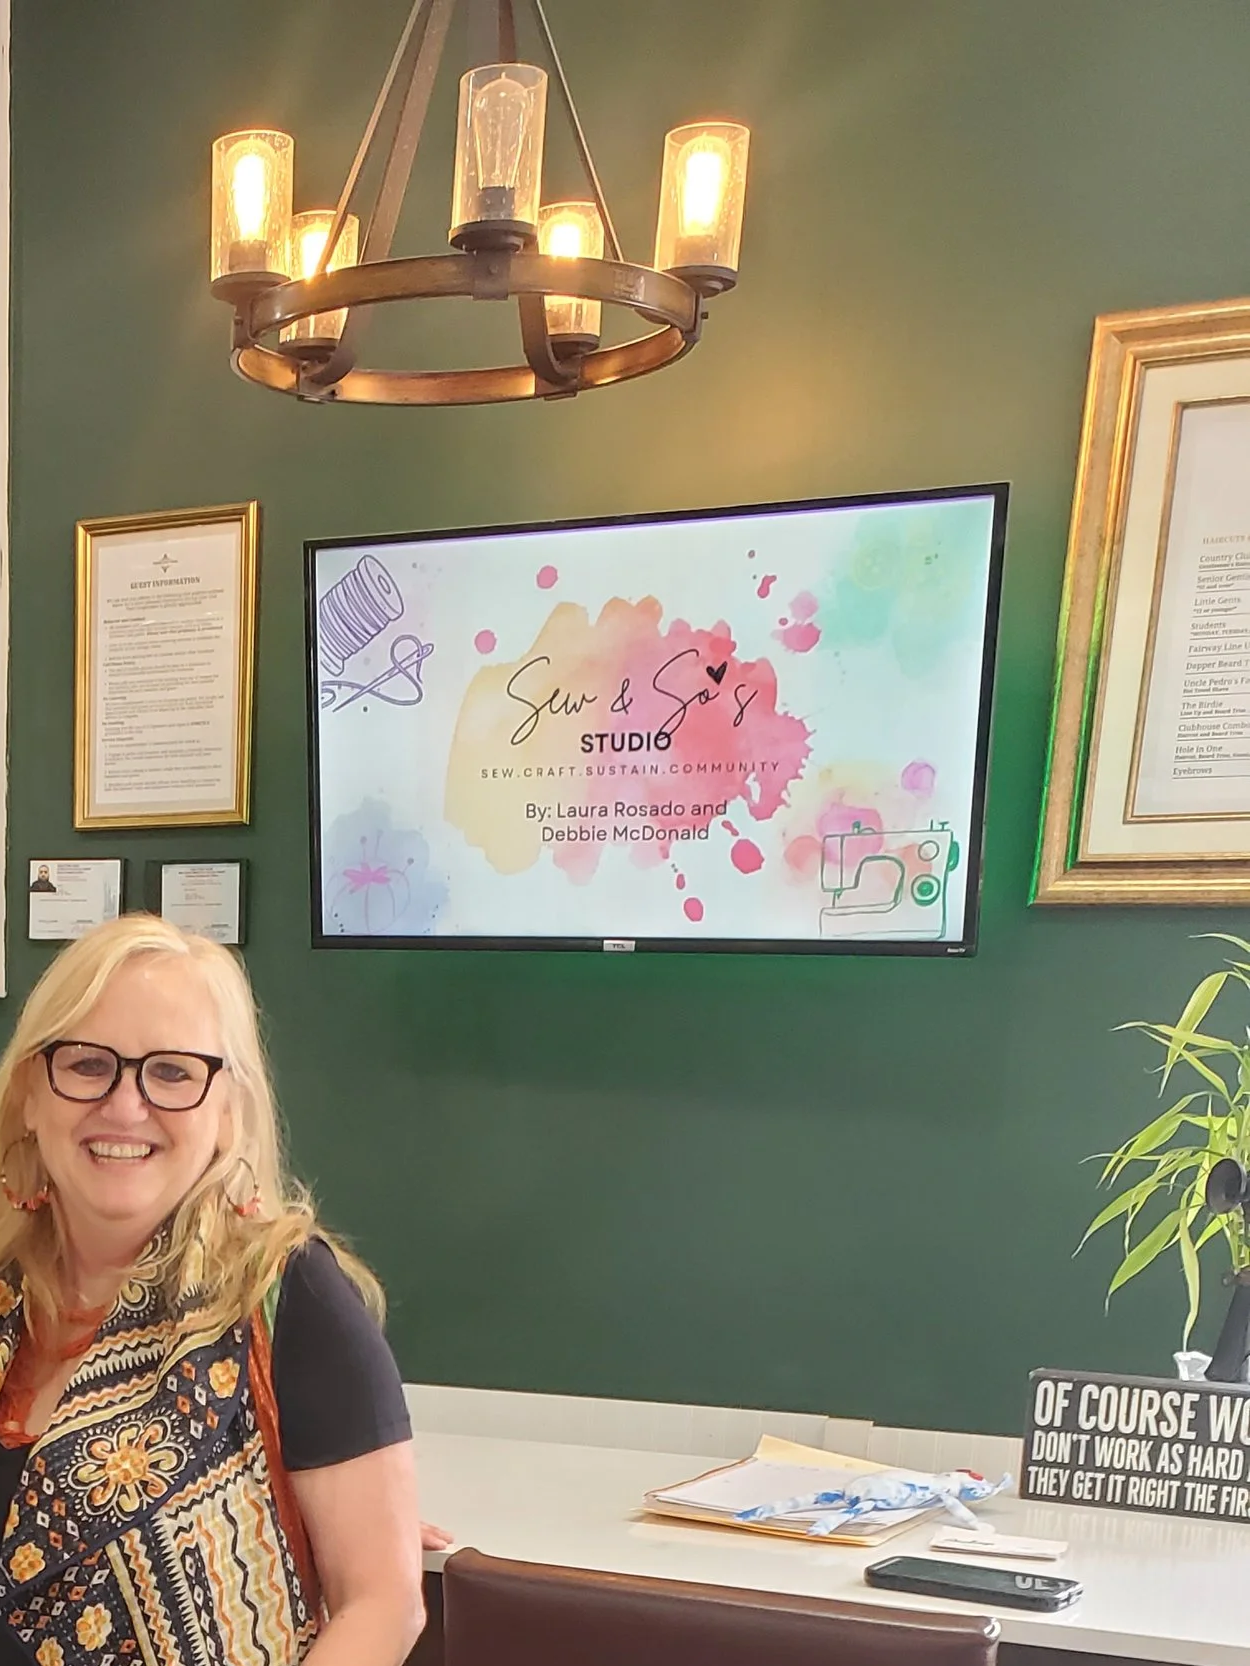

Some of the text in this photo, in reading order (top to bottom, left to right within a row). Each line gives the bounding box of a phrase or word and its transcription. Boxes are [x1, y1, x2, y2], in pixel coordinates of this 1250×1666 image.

[1199, 554, 1234, 563] Country
[130, 576, 200, 589] GUEST INFORMATION
[1197, 575, 1224, 583] Senior
[1194, 598, 1216, 606] Little
[1188, 644, 1223, 653] Fairway
[1224, 643, 1243, 651] Line
[1186, 662, 1217, 671] Dapper
[1217, 659, 1243, 668] Beard
[1183, 679, 1207, 687] Uncle
[506, 656, 598, 746] Sew
[610, 678, 634, 715] &
[1198, 700, 1223, 708] Birdie
[1178, 723, 1221, 732] Clubhouse
[580, 731, 672, 754] STUDIO
[1175, 745, 1195, 754] Hole
[1206, 745, 1223, 753] One
[1172, 767, 1213, 776] Eyebrows
[525, 800, 728, 822] By: Laura Rosado and
[541, 824, 710, 842] Debbie McDonald
[1034, 1380, 1073, 1427] OF
[1078, 1384, 1200, 1440] COURSE
[1031, 1430, 1244, 1481] DON'T WORK AS HARD
[1027, 1466, 1070, 1497] THEY
[1071, 1470, 1105, 1501] GET
[1106, 1474, 1126, 1503] IT
[1126, 1476, 1180, 1509] RIGHT
[1184, 1482, 1219, 1514] THE
